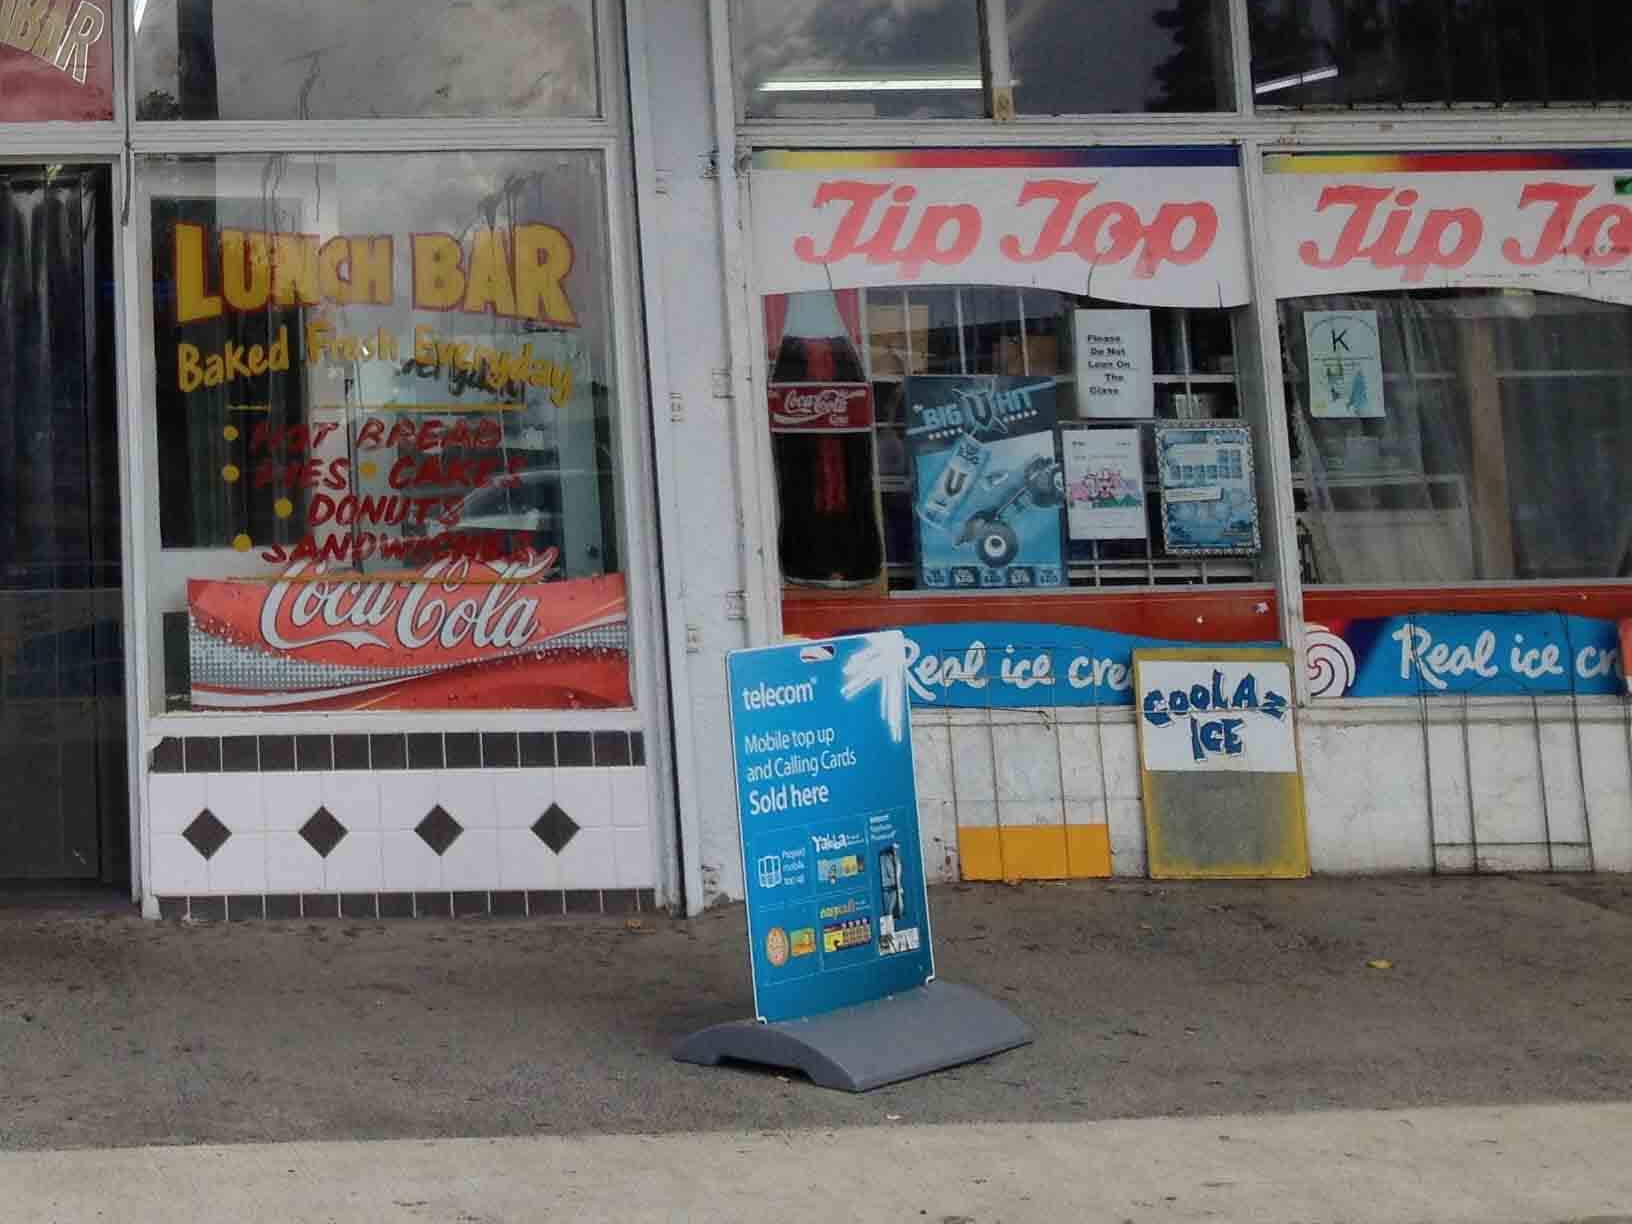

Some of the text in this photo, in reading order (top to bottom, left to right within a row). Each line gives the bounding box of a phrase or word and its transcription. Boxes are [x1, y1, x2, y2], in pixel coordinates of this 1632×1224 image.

[793, 179, 1220, 281] Tip Top
[1298, 184, 1485, 283] Tip
[174, 222, 579, 327] LUNCH BAR
[1087, 334, 1121, 344] Please
[1331, 329, 1351, 352] K
[176, 325, 290, 392] Baked
[252, 417, 503, 454] HOT BREAD
[388, 455, 529, 490] CAKES
[306, 493, 465, 527] DONUTS
[901, 638, 988, 701] Real
[1001, 643, 1056, 689] ice
[1391, 623, 1499, 690] Real
[1510, 633, 1565, 679] ice
[742, 680, 815, 711] telecom
[744, 727, 835, 754] Mobile top up
[1190, 717, 1246, 761] ICE
[746, 746, 857, 783] and Calling Cards
[749, 782, 830, 816] Sold here
